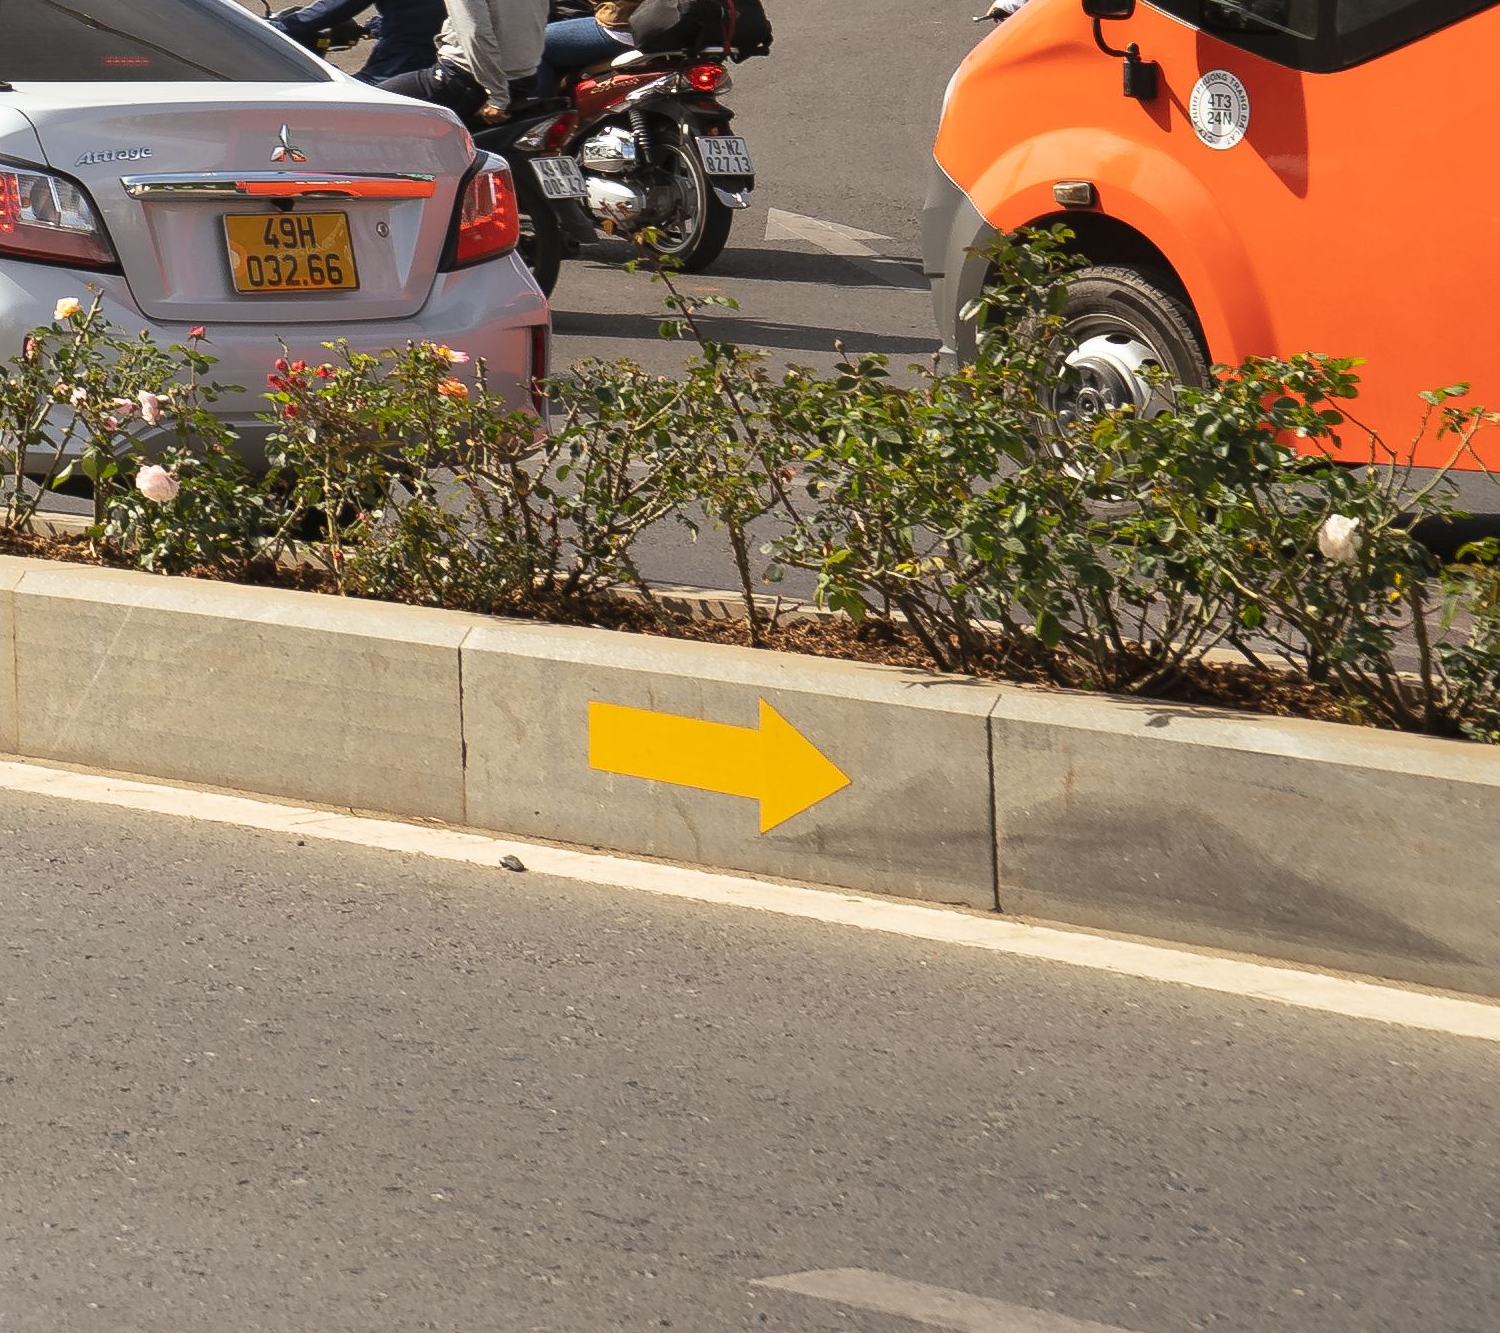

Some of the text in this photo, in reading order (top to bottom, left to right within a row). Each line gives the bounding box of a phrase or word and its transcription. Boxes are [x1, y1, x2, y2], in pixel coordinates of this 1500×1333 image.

[1207, 93, 1232, 109] 4T3
[1207, 111, 1232, 125] 24N
[75, 147, 152, 167] Attrage
[707, 156, 750, 174] 827.13
[263, 217, 317, 249] 49H
[247, 253, 344, 287] 032.66
